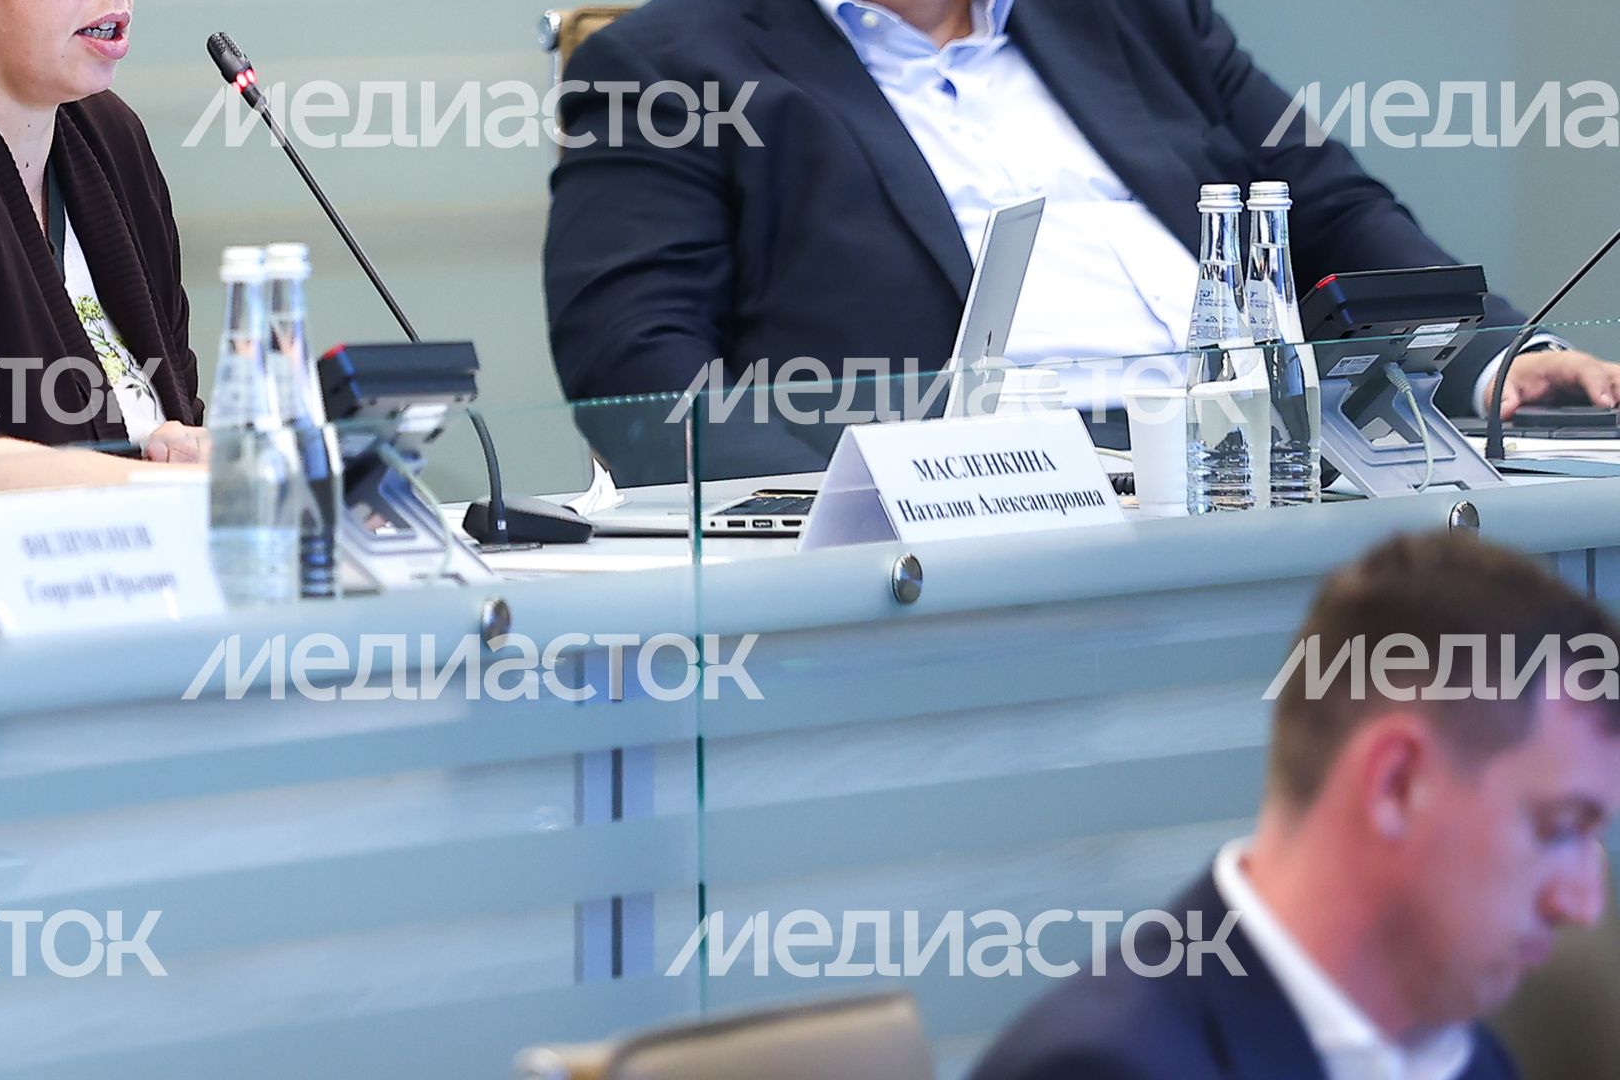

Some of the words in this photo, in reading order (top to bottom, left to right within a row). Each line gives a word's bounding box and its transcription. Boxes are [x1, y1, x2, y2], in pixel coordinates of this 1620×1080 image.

[912, 448, 1058, 482] МАСЛЕНКИНА
[896, 498, 976, 523] Наталия
[979, 486, 1107, 517] Александровна
